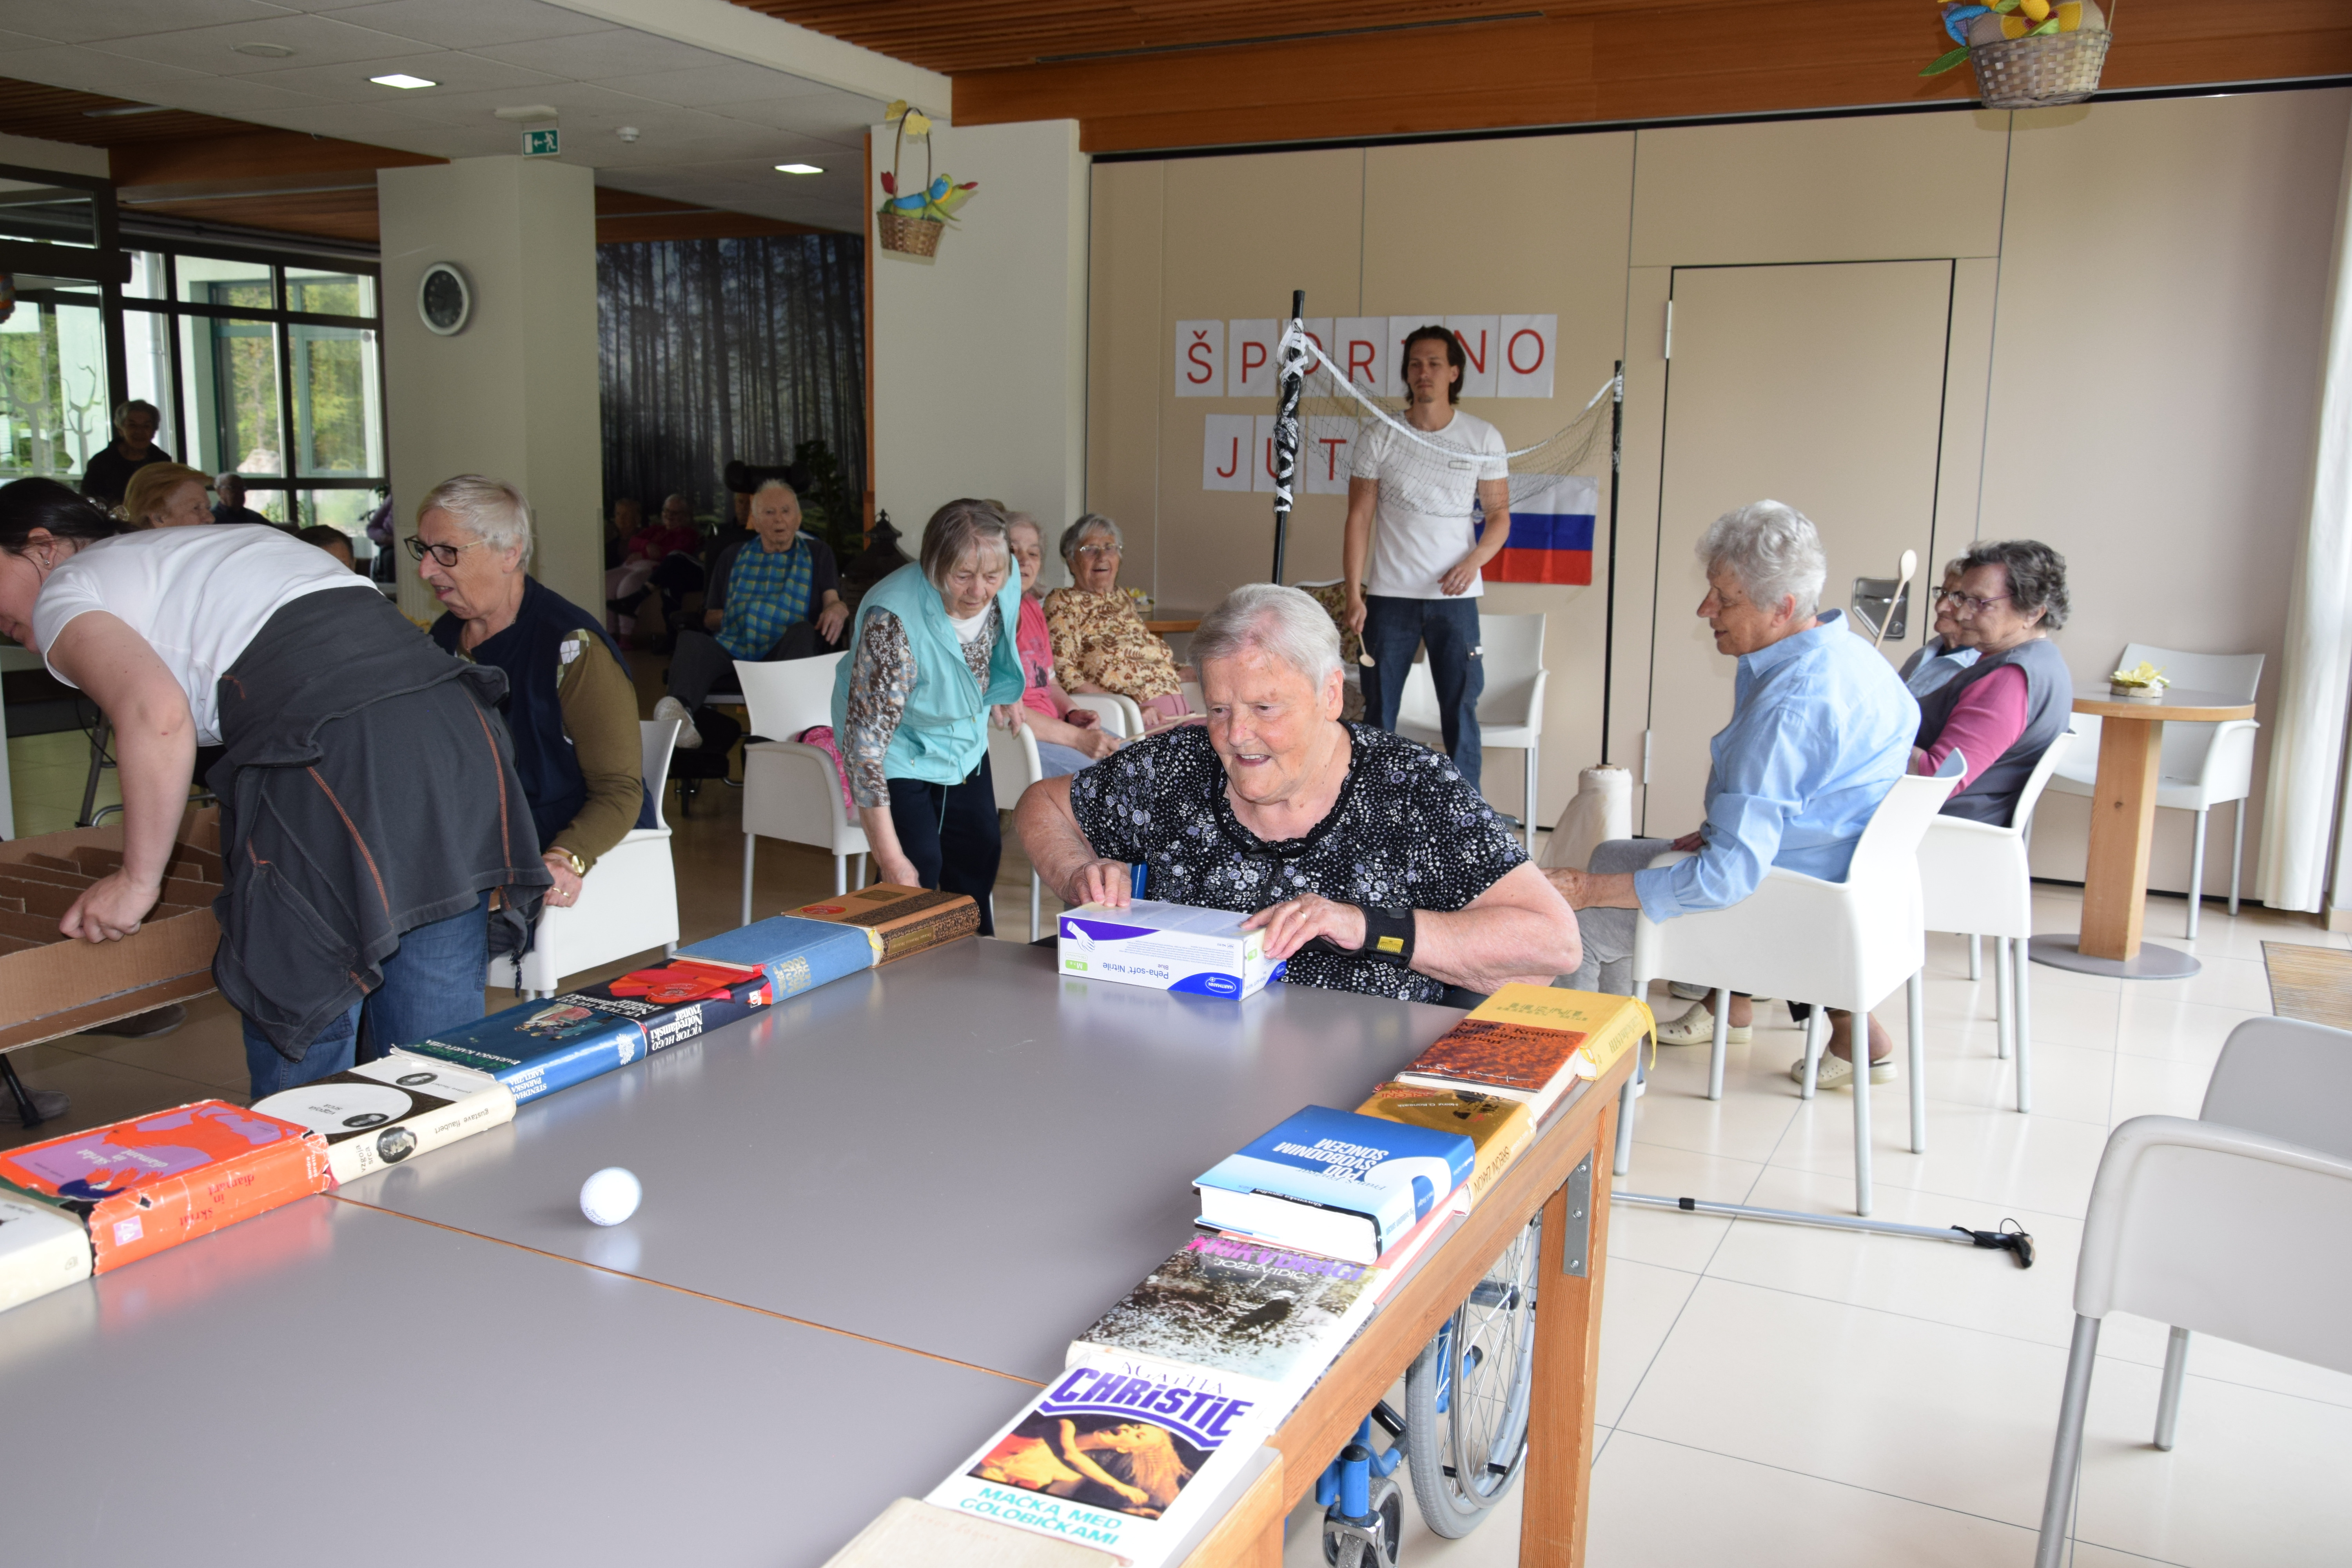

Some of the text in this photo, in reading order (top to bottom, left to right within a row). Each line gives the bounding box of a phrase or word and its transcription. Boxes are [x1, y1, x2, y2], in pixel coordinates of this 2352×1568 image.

[1187, 328, 1544, 384] ŠPORNO
[1102, 962, 1125, 974] Nitrile
[1208, 982, 1233, 990] HARTMANN
[556, 998, 641, 1018] VICTOR HUGO
[675, 1004, 702, 1021] zvonar
[650, 1013, 703, 1043] Notredamski
[651, 1025, 702, 1051] VICTOR HUGO
[1514, 1027, 1573, 1039] Kranjec
[1448, 1033, 1501, 1045] Roman
[474, 1052, 522, 1065] PARMSKA
[511, 1077, 542, 1093] PARMSKA
[513, 1083, 547, 1101] STENDHAL
[308, 1106, 336, 1116] vzgoja
[434, 1108, 489, 1135] gustave flaubert
[356, 1144, 367, 1173] vzgoja
[367, 1146, 375, 1165] srca
[1272, 1141, 1377, 1171] SVOBODNIM
[1313, 1138, 1389, 1161] SONCEM
[1322, 1164, 1365, 1180] POD
[1475, 1146, 1510, 1194] SREČNI ZAKON
[208, 1173, 255, 1196] diamant
[213, 1193, 225, 1205] in
[1255, 1189, 1324, 1207] Slovenska zgodba
[1186, 1235, 1367, 1282] KRIK V DRAGI
[1214, 1259, 1309, 1279] JOŽE VIDIC
[1120, 1361, 1224, 1395] AGATHA
[977, 1487, 1122, 1532] MAČKA MED
[959, 1497, 1119, 1546] GOLOBIČKAMI
